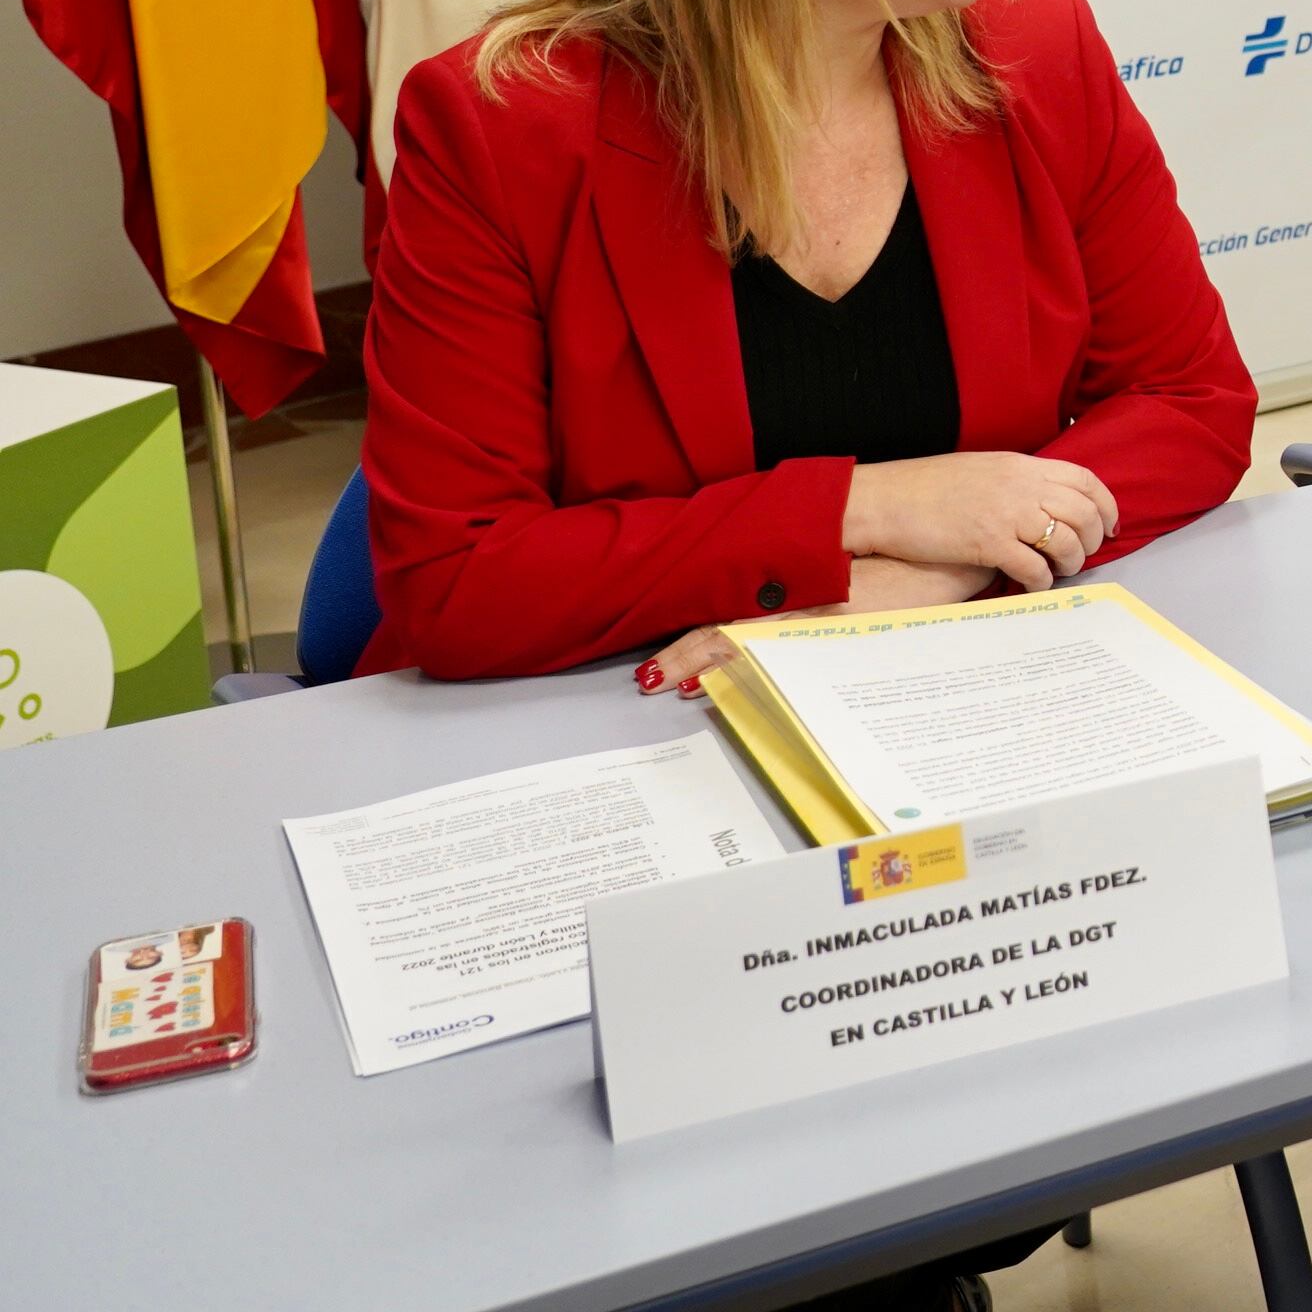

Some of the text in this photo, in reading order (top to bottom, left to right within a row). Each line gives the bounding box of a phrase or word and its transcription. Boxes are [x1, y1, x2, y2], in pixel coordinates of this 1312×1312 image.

[1118, 55, 1183, 82] áfico
[744, 868, 1146, 971] Dña. INMACULADA MATÍAS FDEZ.
[781, 922, 1116, 1012] COORDINADORA DE LA DGT
[831, 972, 1088, 1047] EN CASTILLA Y LEÓN
